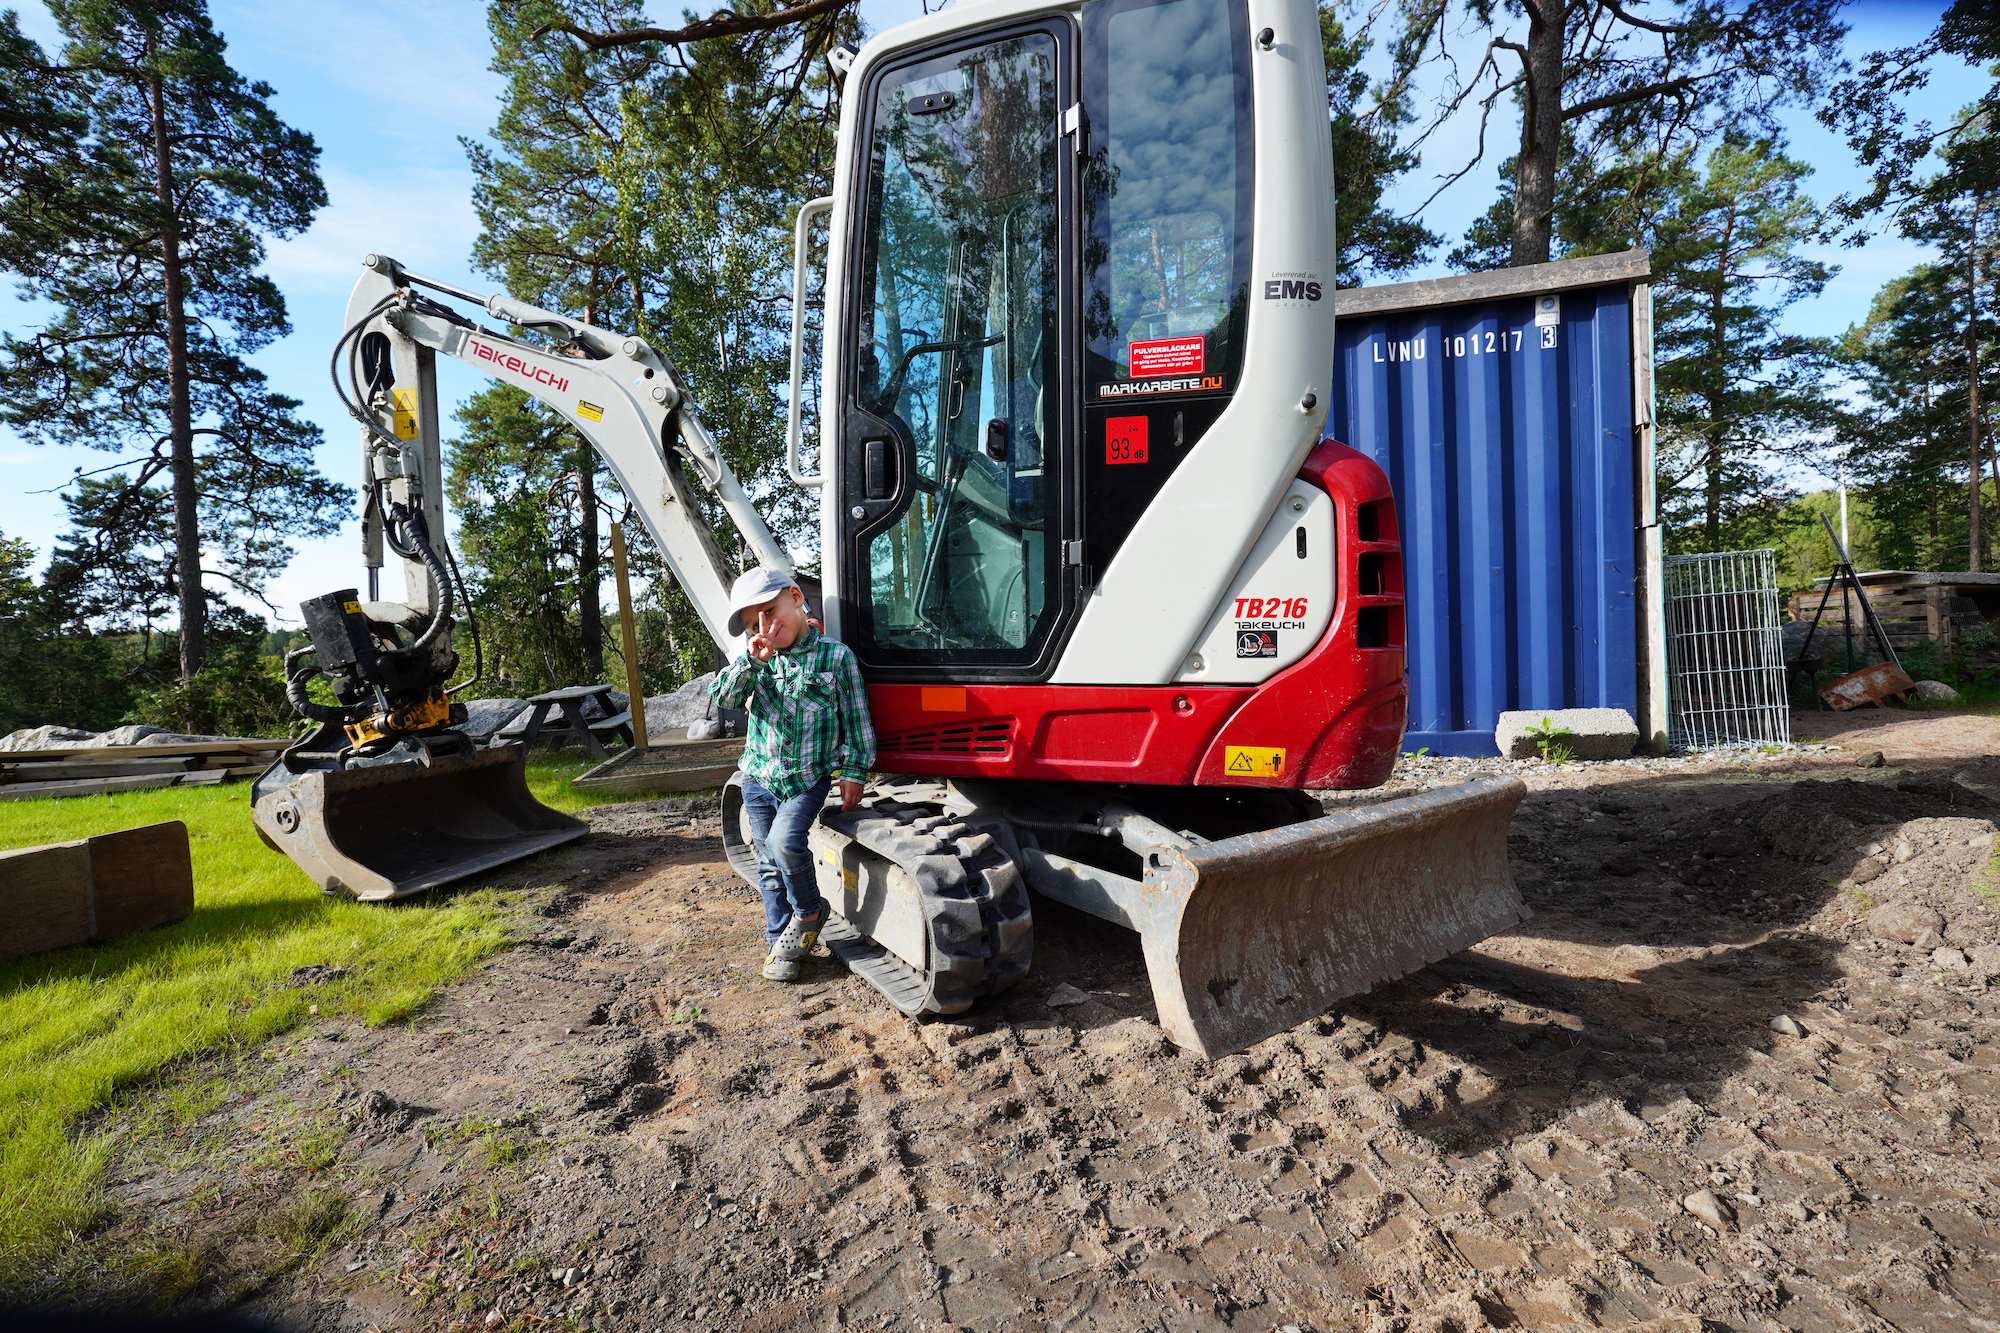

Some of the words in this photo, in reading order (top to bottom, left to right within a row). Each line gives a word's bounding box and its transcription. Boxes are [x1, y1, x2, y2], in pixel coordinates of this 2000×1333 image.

[1264, 280, 1322, 301] EMS
[1133, 343, 1201, 355] PULVERSLÄCKARE
[1373, 338, 1426, 363] LVNU
[1443, 330, 1523, 358] 101217
[1543, 326, 1555, 348] 3
[1111, 438, 1130, 460] 93
[1134, 449, 1145, 459] dB
[1234, 597, 1308, 619] TB216
